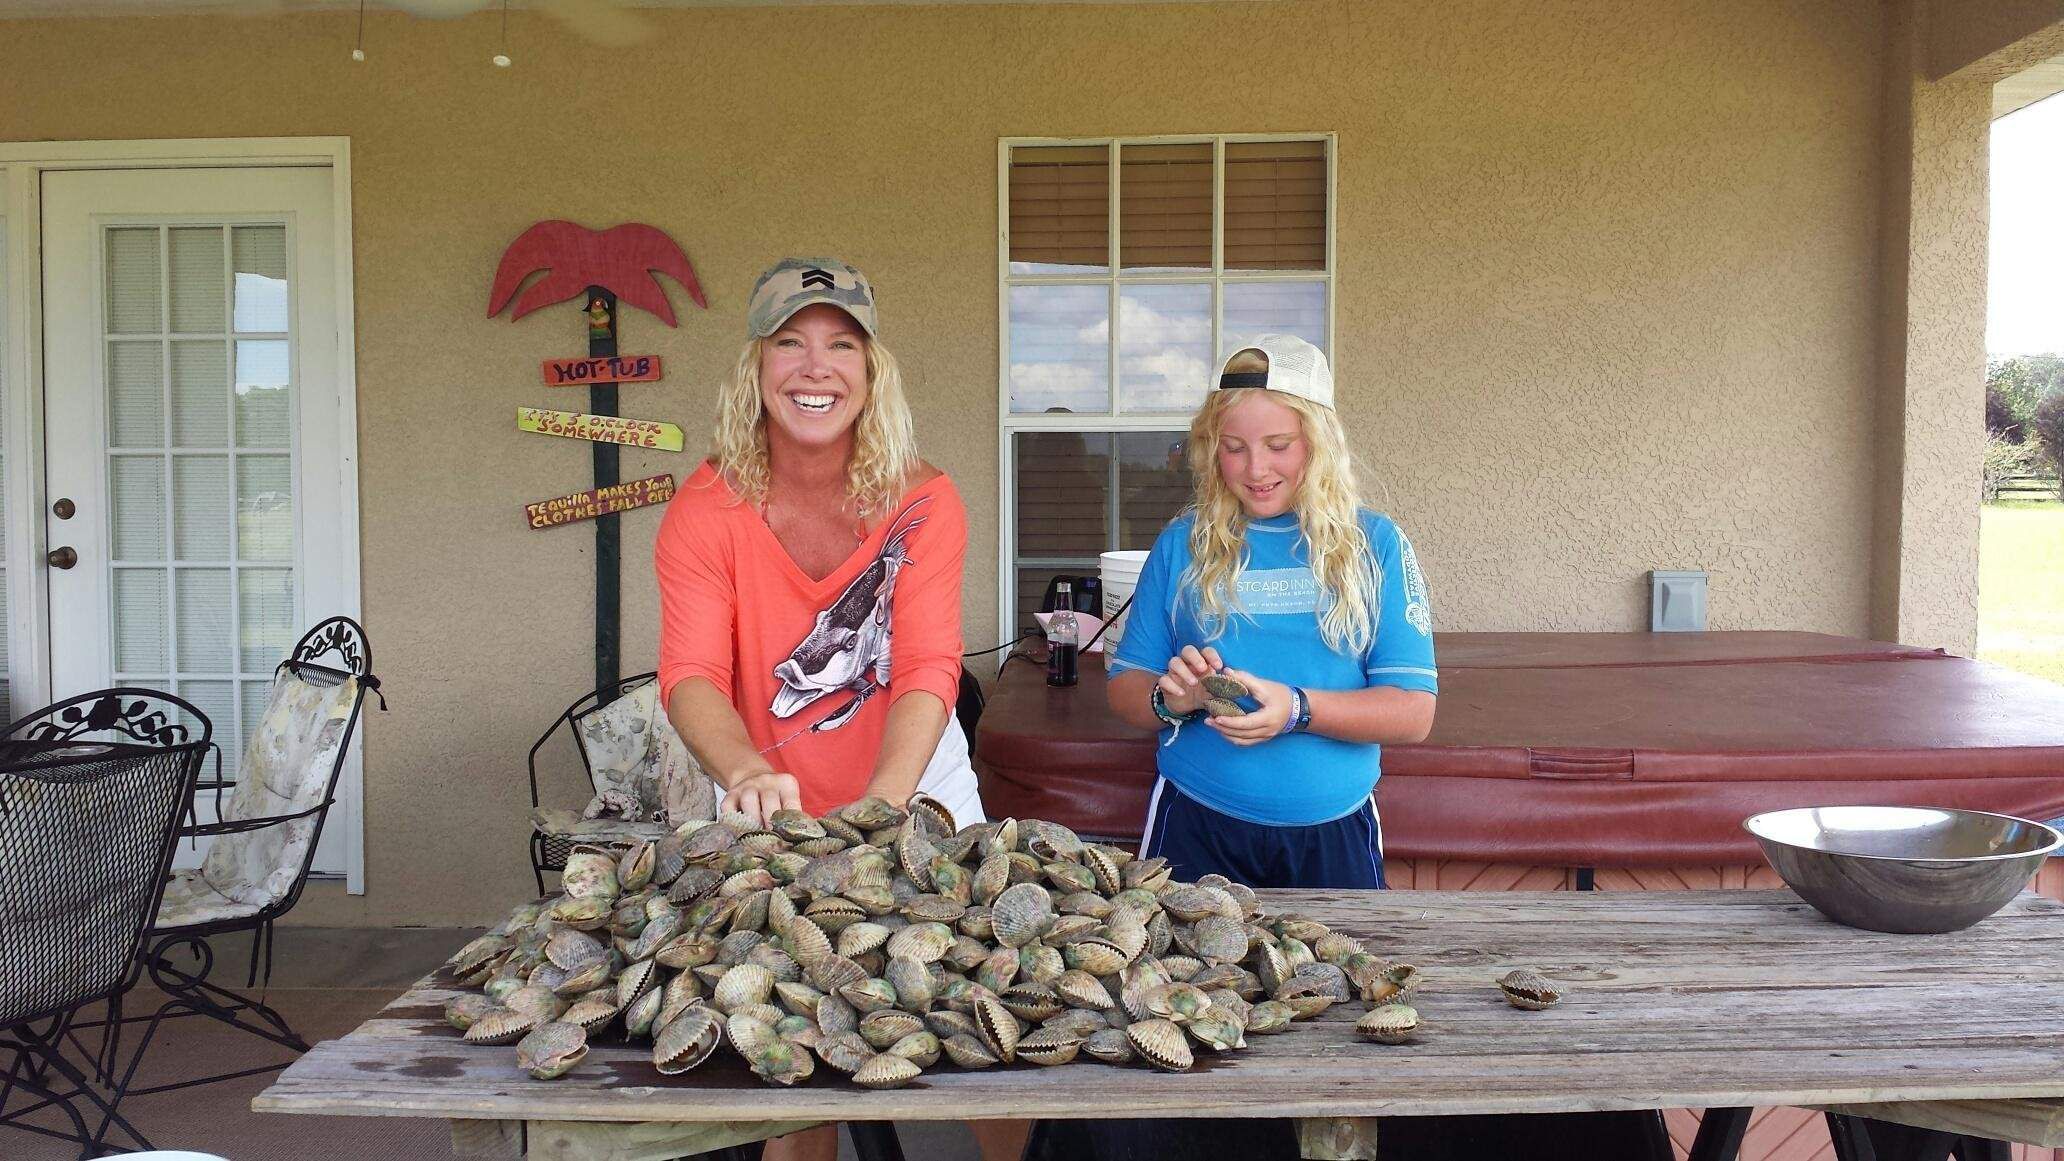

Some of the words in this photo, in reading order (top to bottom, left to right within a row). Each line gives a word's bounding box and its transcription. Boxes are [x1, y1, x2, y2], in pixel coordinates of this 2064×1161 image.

[537, 419, 657, 447] SOMEWHERE
[597, 481, 641, 500] MAKES
[532, 503, 602, 528] CLOTHES
[609, 497, 643, 512] FALL
[647, 489, 673, 503] OFF
[1216, 580, 1289, 592] PSTCARD
[1291, 579, 1315, 590] INN
